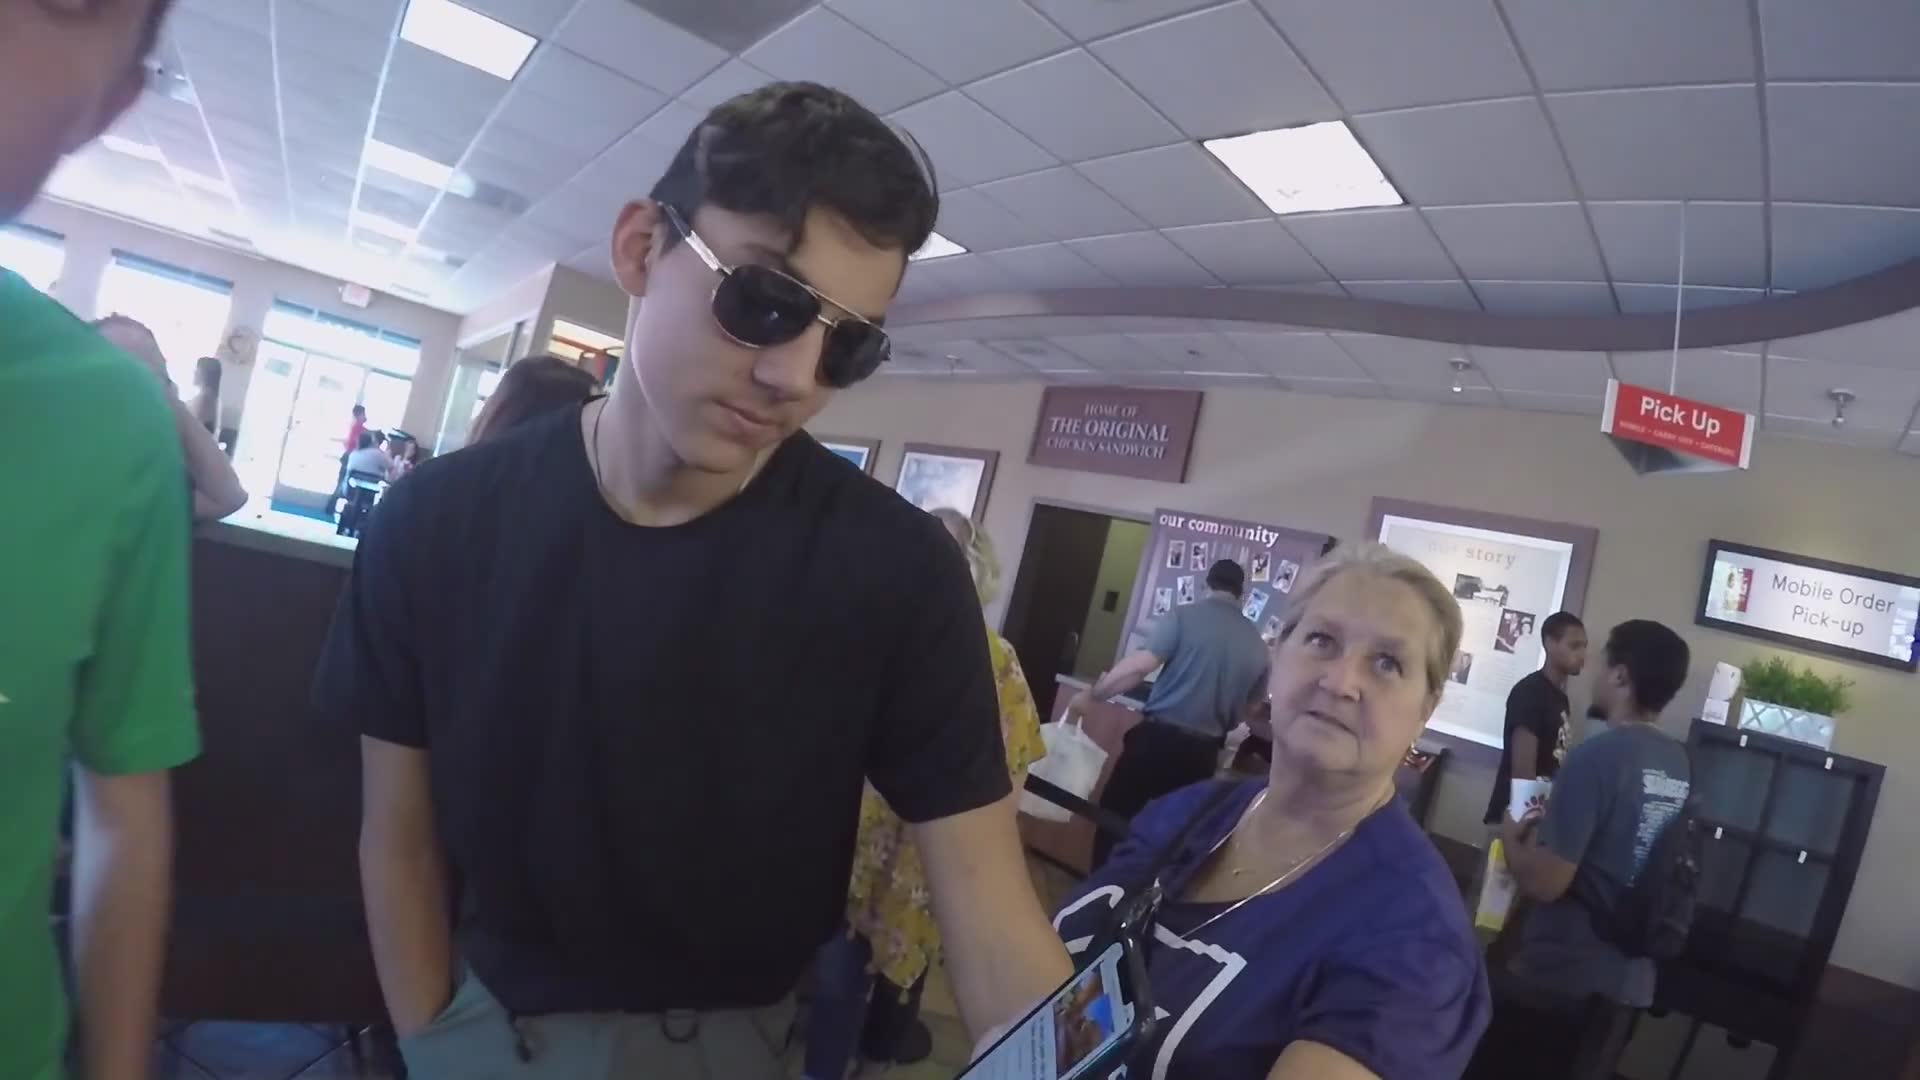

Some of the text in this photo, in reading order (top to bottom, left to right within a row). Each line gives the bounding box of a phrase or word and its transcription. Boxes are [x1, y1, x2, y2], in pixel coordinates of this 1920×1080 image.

[1084, 403, 1139, 418] HOME OF
[1640, 395, 1721, 438] Pick Up
[1049, 416, 1170, 443] THE ORIGINAL
[1046, 437, 1166, 460] CHICKEN SANDWICH
[1159, 514, 1280, 548] our community
[1465, 546, 1517, 569] story
[1772, 573, 1895, 614] Mobile Order
[1792, 604, 1864, 638] Pick-up
